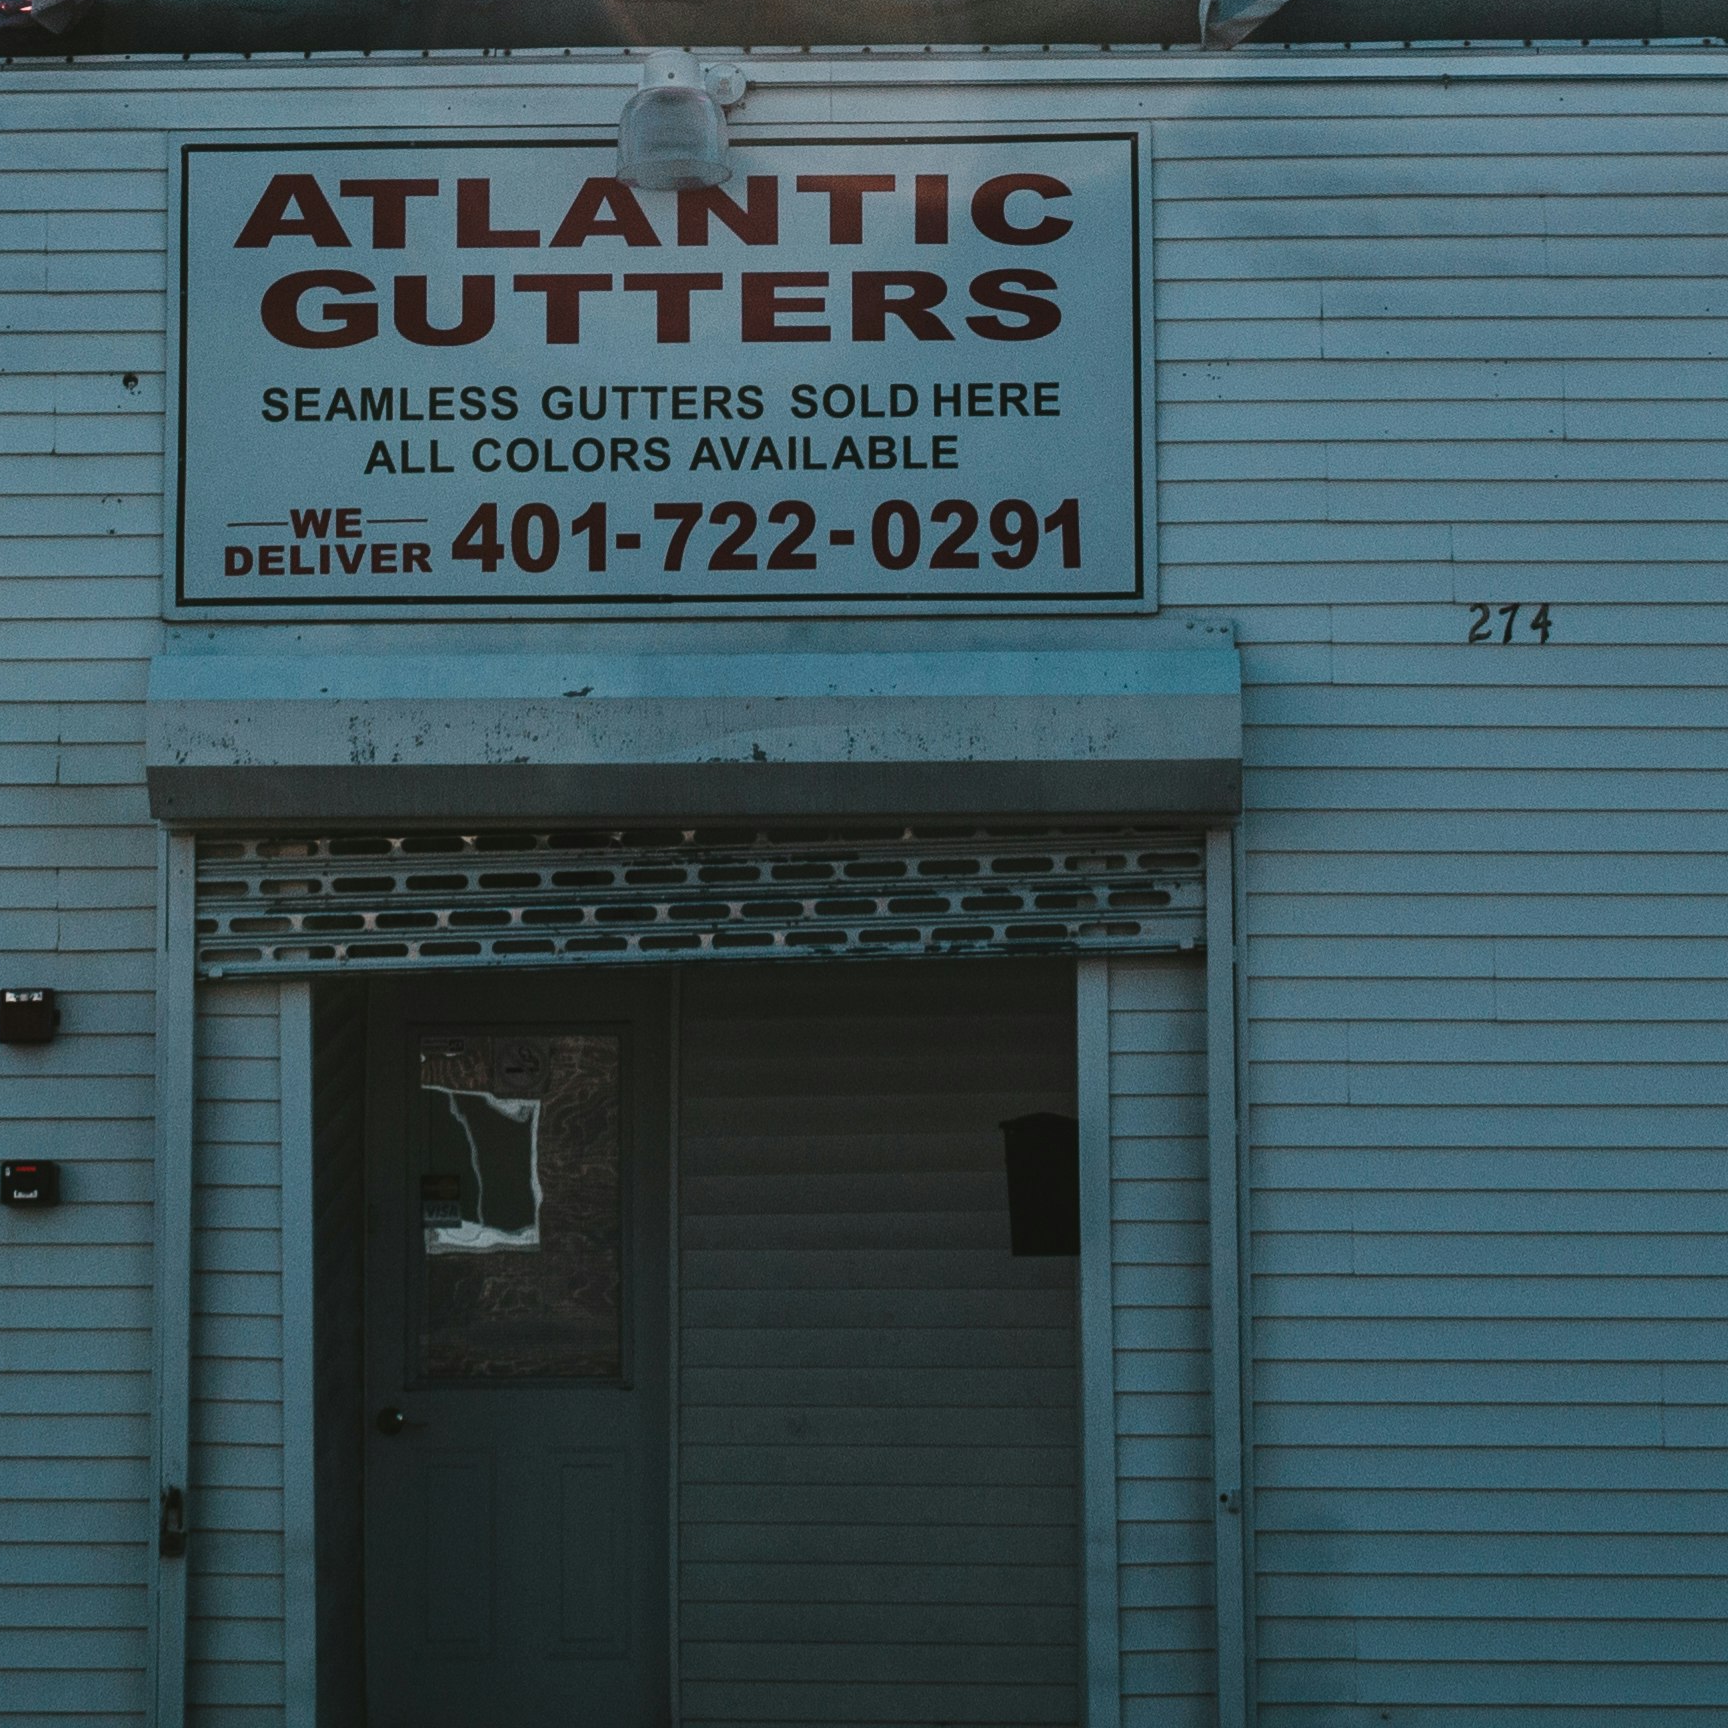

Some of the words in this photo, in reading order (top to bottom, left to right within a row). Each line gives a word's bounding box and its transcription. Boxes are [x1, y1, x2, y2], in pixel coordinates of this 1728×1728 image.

[233, 173, 1074, 249] ATLANTIC
[260, 268, 1062, 350] GUTTERS
[261, 385, 519, 423] SEAMLESS
[541, 384, 764, 421] GUTTERS
[791, 383, 919, 419] SOLD
[933, 382, 1061, 417] HERE
[364, 439, 455, 475] ALL
[472, 436, 671, 473] COLORS
[689, 435, 959, 471] AVAILABLE
[290, 507, 363, 539] WE
[451, 498, 1081, 574] 401-722-0291
[224, 542, 432, 577] DELIVER
[1468, 603, 1553, 645] 274
